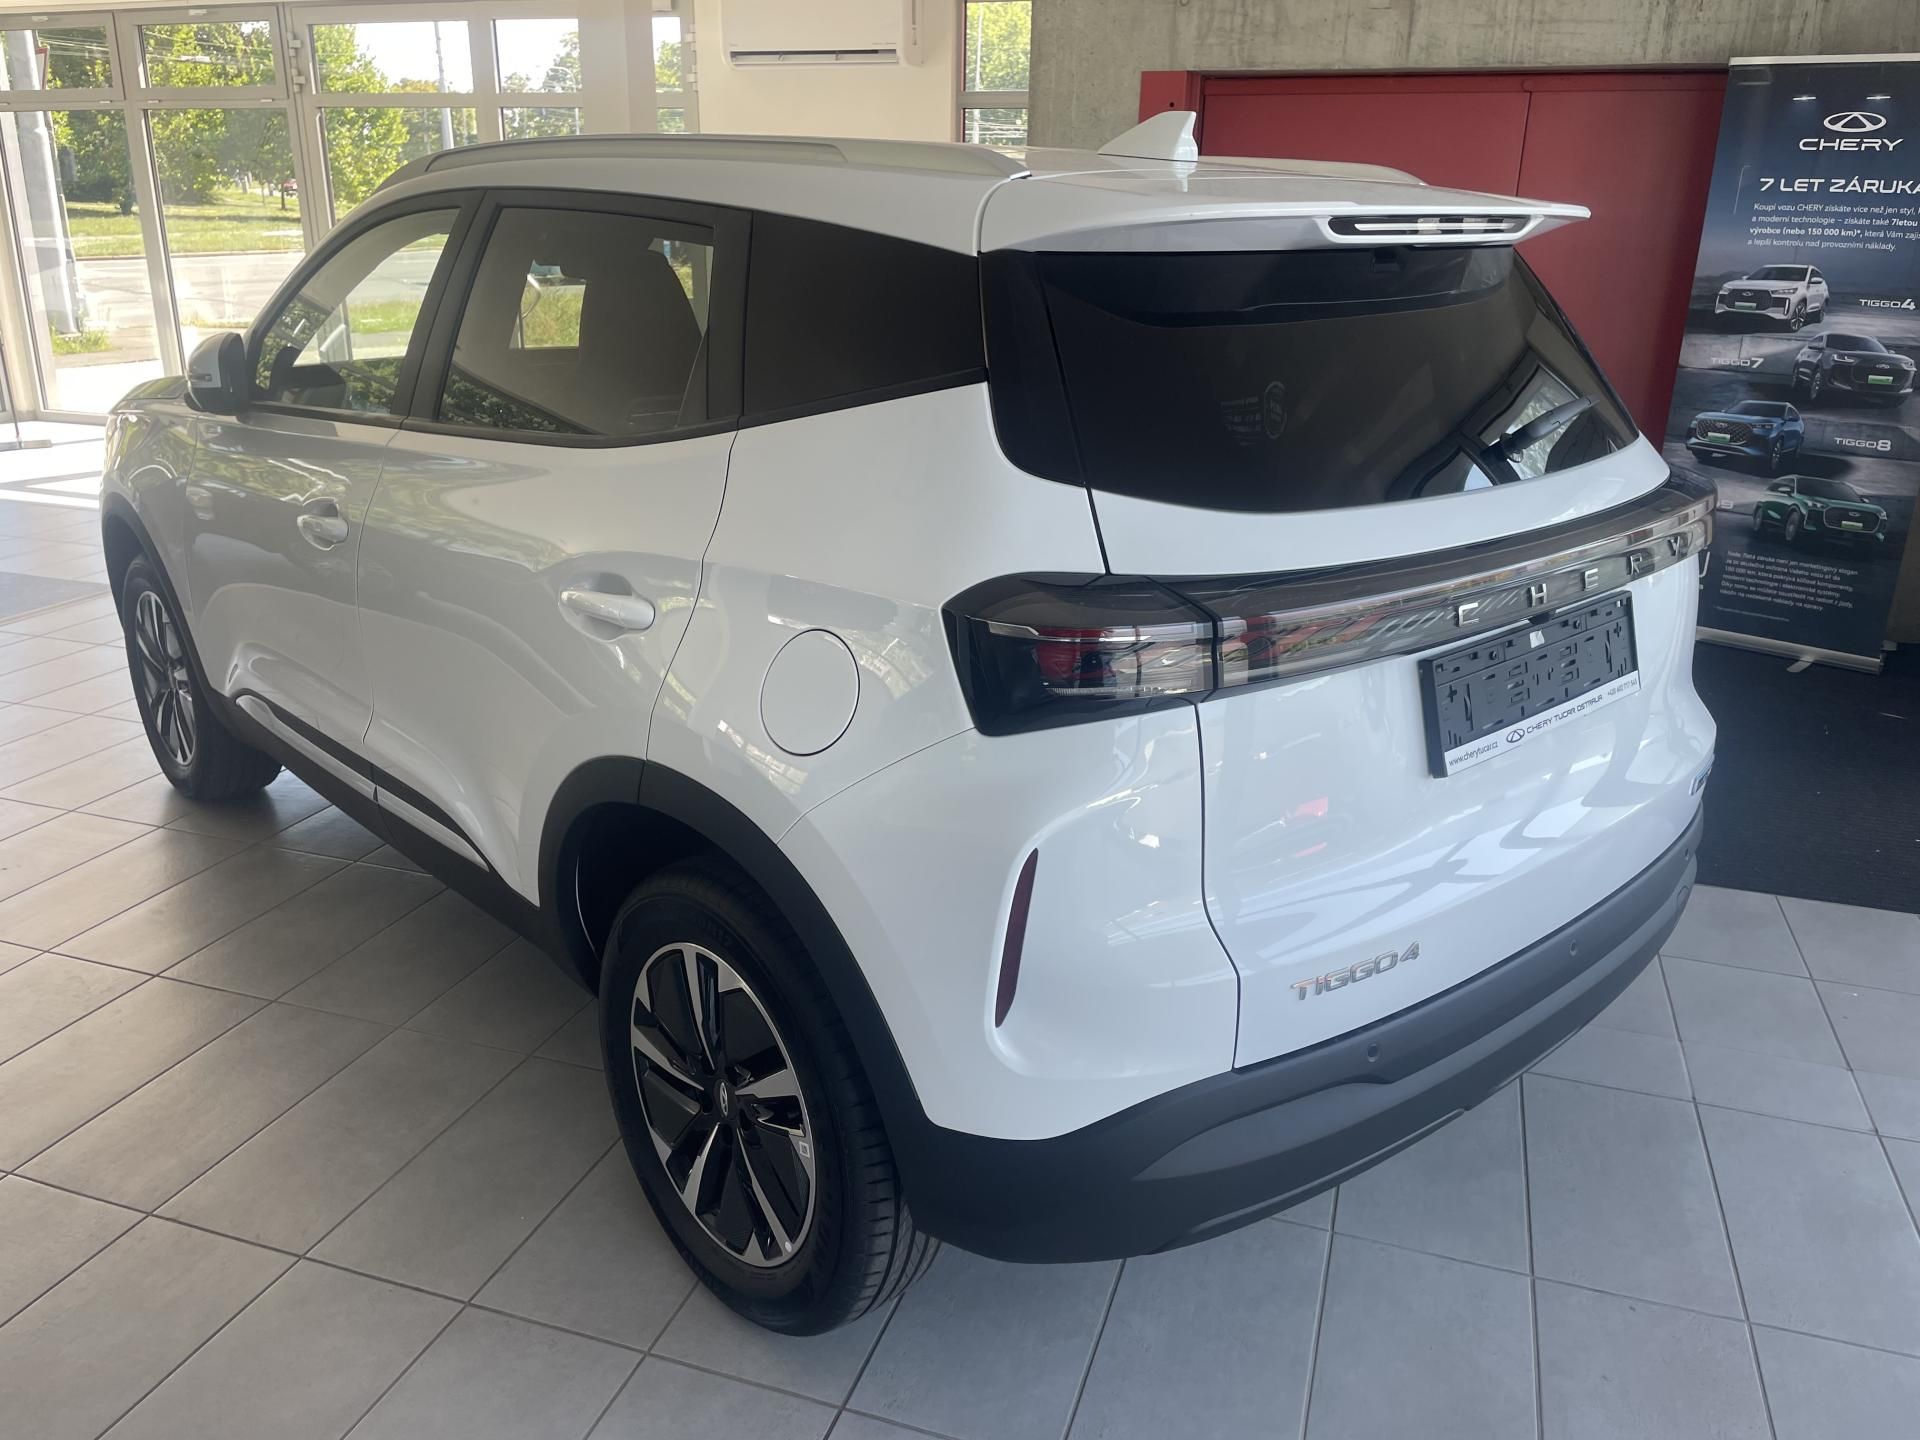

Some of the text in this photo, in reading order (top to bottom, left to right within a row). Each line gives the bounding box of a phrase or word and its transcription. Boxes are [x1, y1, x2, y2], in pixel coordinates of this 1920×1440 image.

[1799, 138, 1904, 151] CHERY
[1759, 178, 1775, 192] 7
[1779, 178, 1825, 192] LET
[1797, 203, 1824, 212] CHERY
[1884, 206, 1898, 215] jen
[1791, 215, 1836, 226] technologie
[1891, 218, 1918, 227] 7letou
[1808, 227, 1822, 235] 150
[1823, 228, 1840, 236] 000
[1864, 229, 1885, 238] která
[1886, 230, 1904, 238] Vám
[1859, 298, 1916, 310] TIGGO4
[1711, 357, 1764, 369] TIGGO7
[1834, 437, 1892, 451] TIGGO8
[1457, 535, 1682, 628] CHERY
[1526, 716, 1553, 734] CHERY
[1554, 707, 1577, 721] TUCAR
